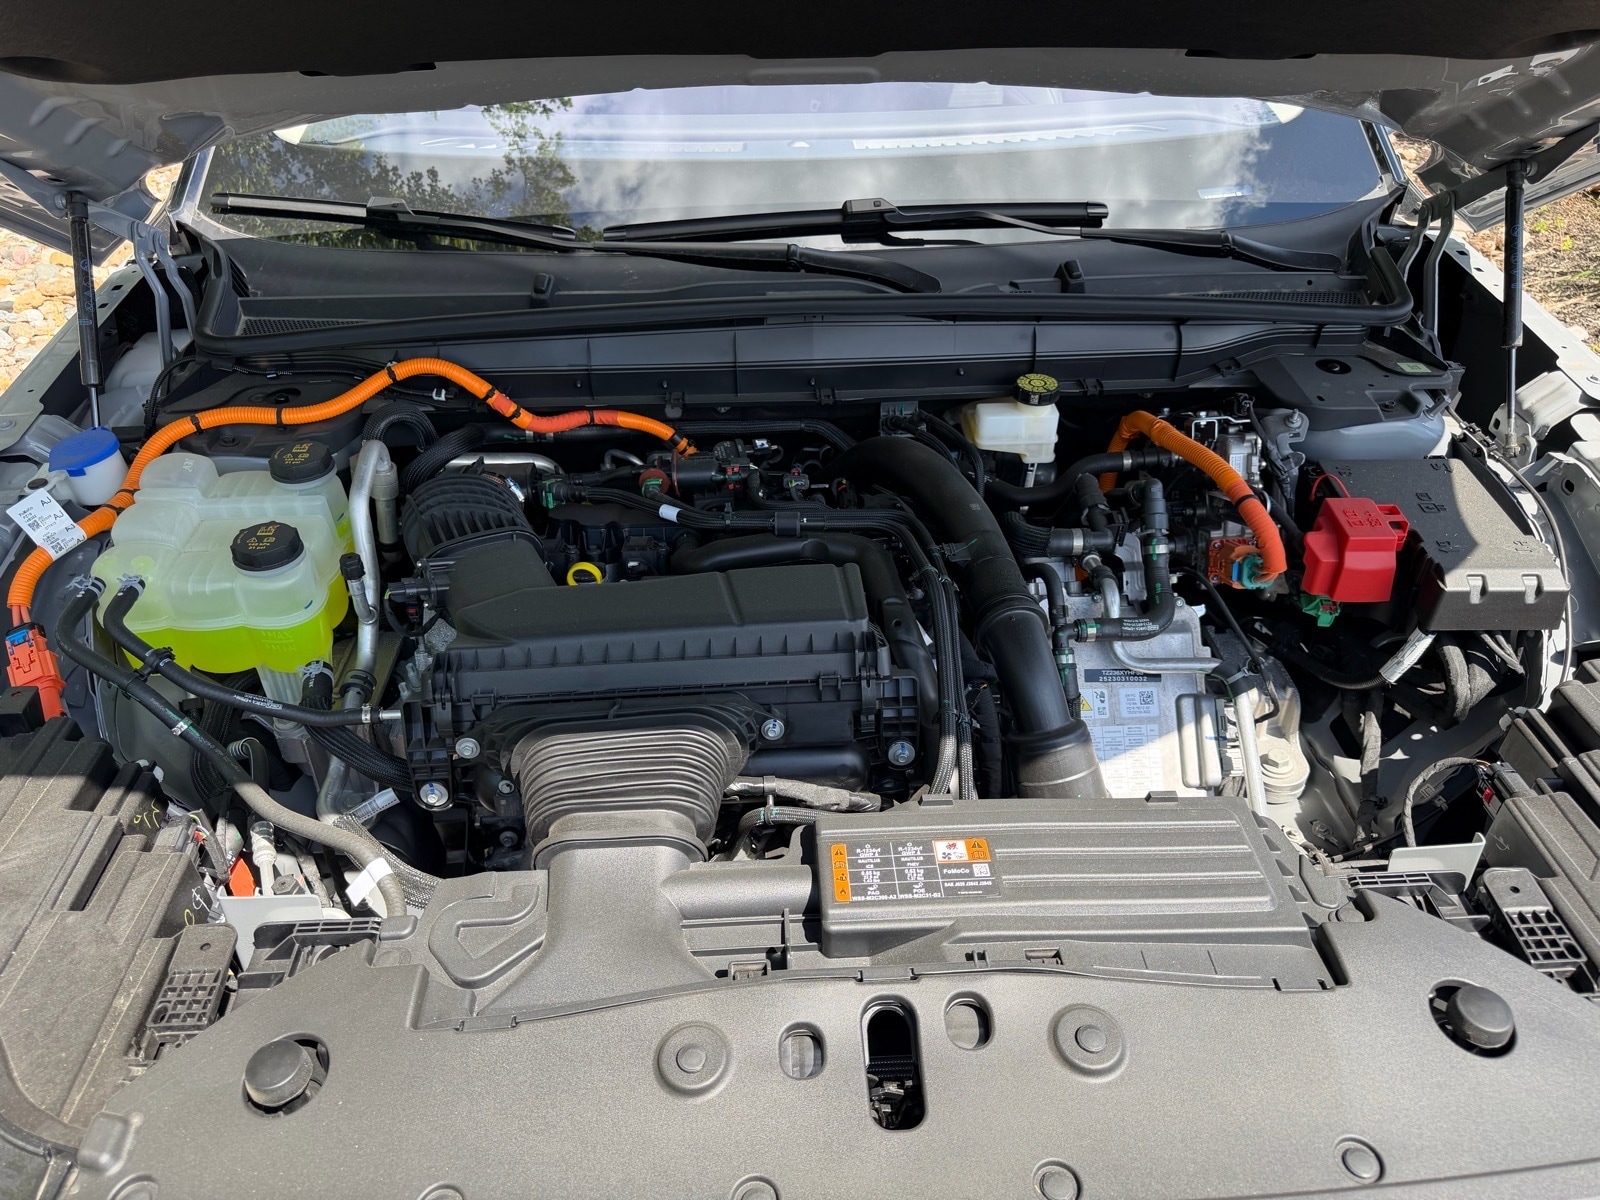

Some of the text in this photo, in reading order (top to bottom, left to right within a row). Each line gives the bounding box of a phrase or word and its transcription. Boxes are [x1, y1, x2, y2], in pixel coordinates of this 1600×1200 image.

[40, 496, 52, 507] AJ
[54, 510, 64, 520] AJ
[65, 524, 76, 532] AJ
[76, 535, 86, 544] AJ
